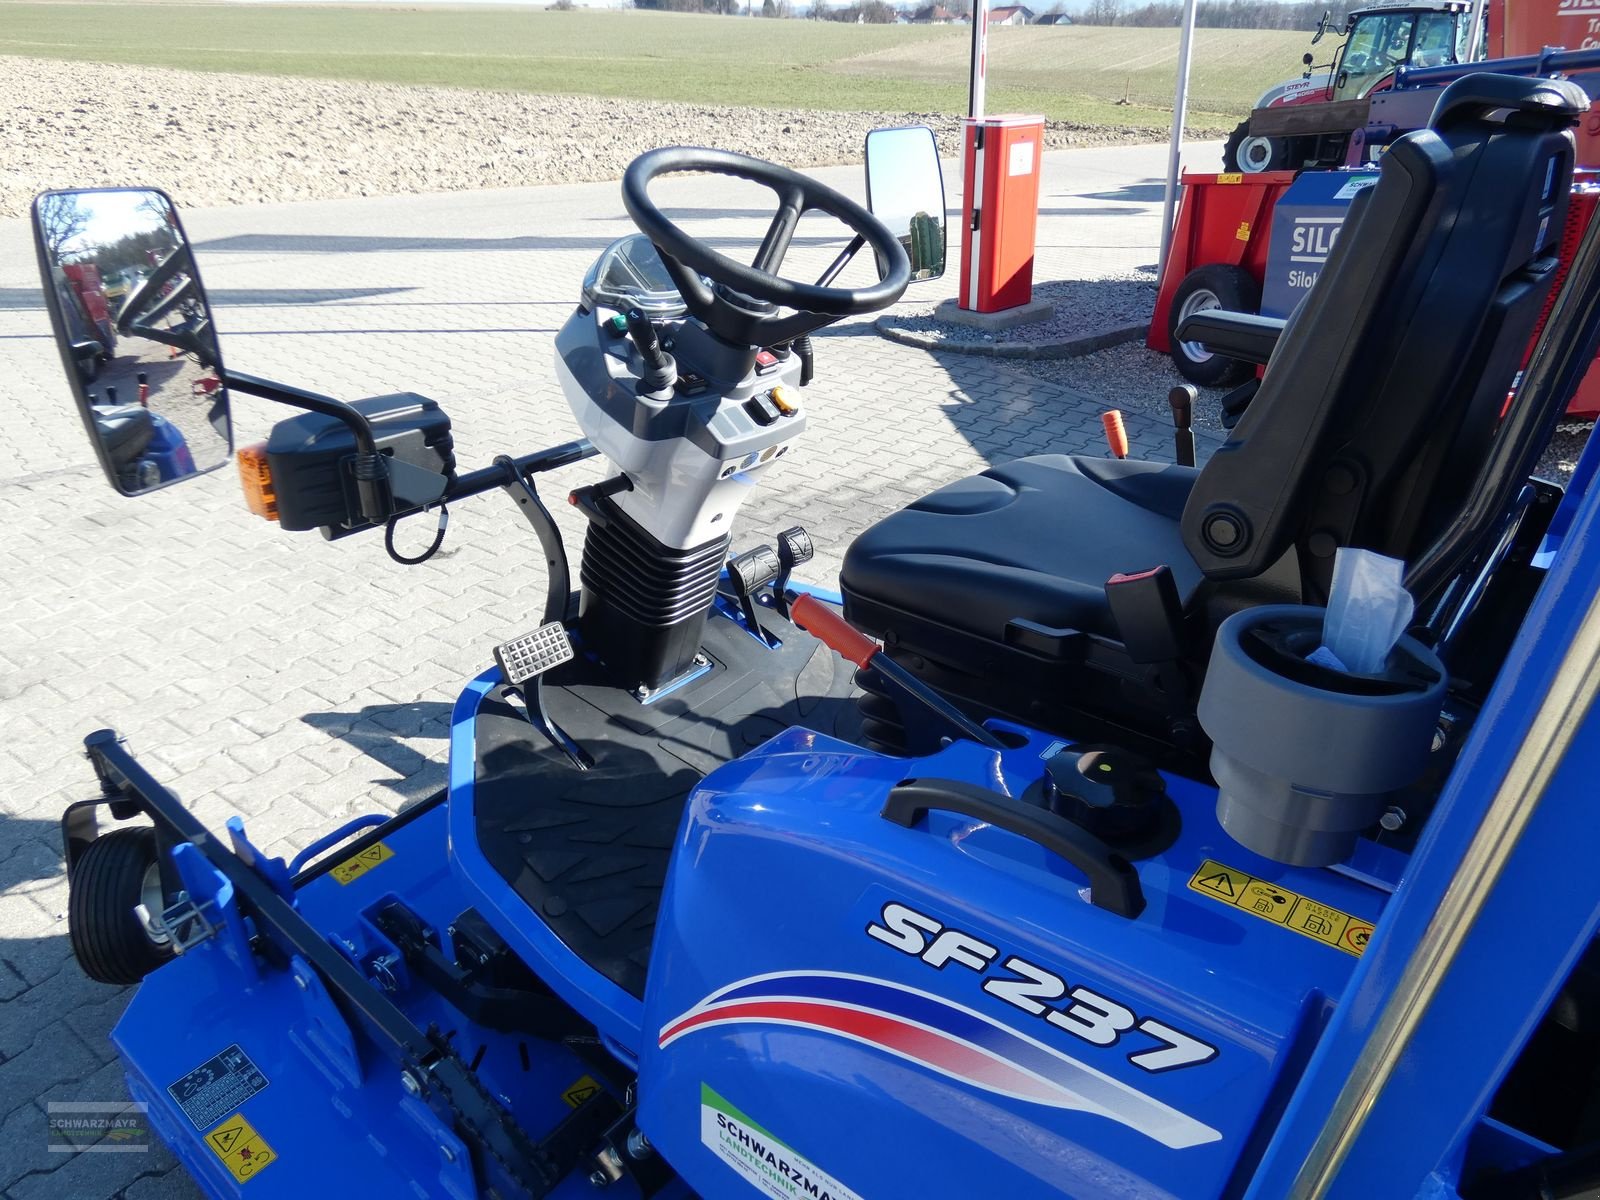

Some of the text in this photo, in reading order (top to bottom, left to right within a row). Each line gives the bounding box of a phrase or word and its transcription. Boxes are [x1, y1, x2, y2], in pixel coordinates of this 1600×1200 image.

[1286, 81, 1311, 91] STEYR
[866, 902, 1219, 1074] SF 237
[719, 1130, 797, 1196] LANDTECHNIK
